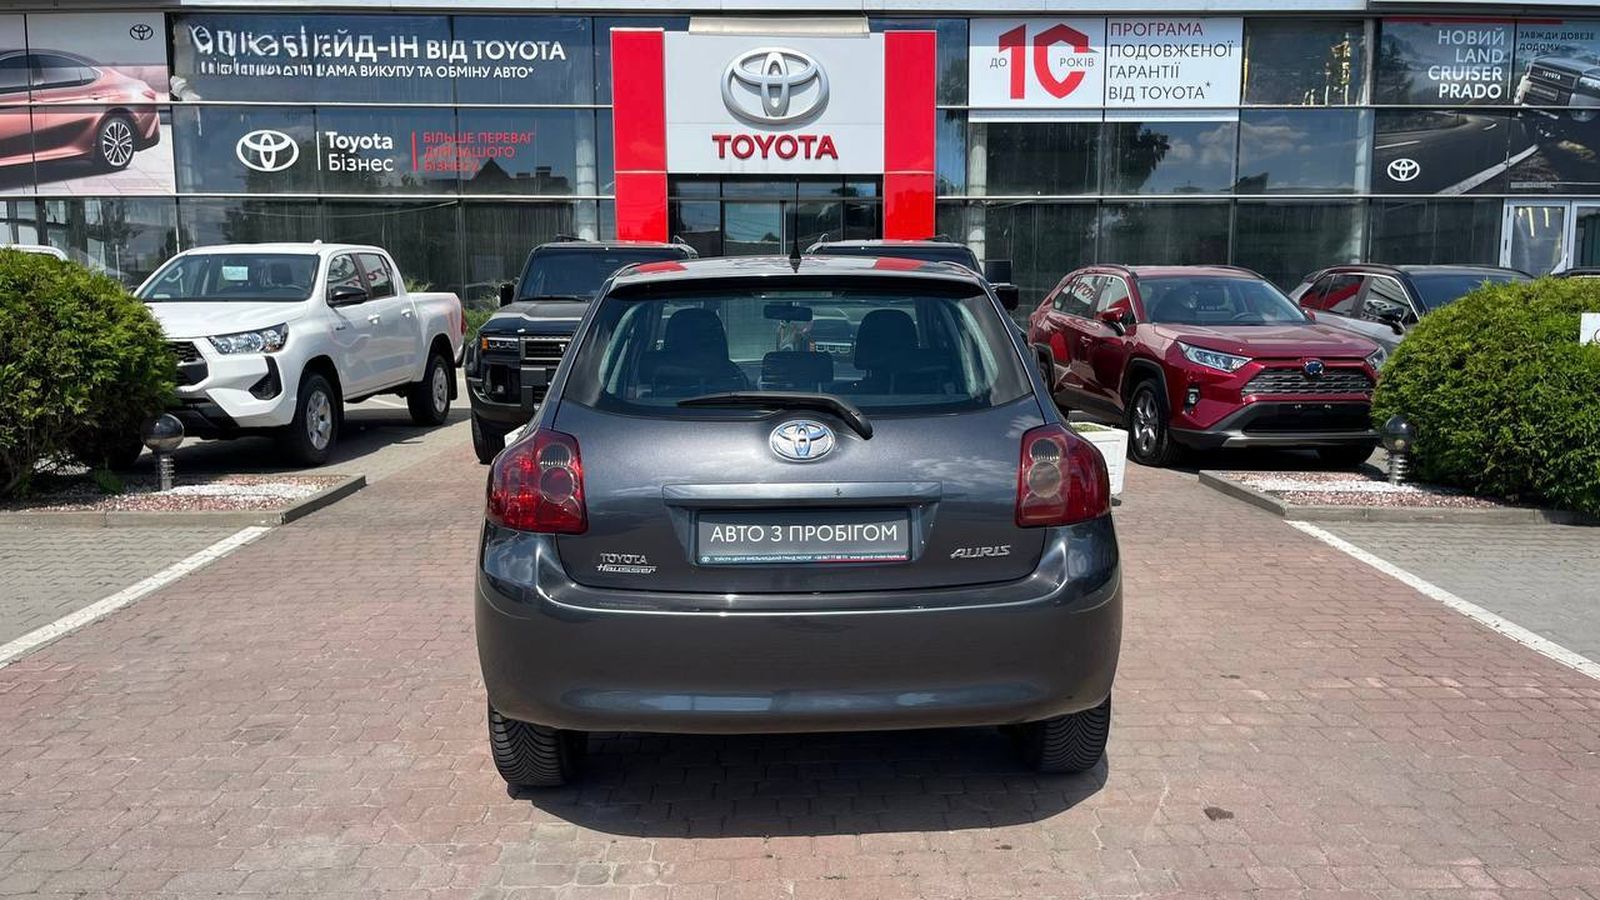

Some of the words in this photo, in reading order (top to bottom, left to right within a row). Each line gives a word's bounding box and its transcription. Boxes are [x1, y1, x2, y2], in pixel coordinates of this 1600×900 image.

[1109, 22, 1203, 37] ПРОГРАМА
[1438, 28, 1505, 46] НОВИЙ
[426, 40, 468, 62] ВІД
[473, 40, 566, 60] TOYOTA
[1109, 40, 1234, 59] ПОДОВЖЕНОЇ
[1455, 48, 1504, 64] LAND
[990, 57, 1007, 69] ДО
[1059, 57, 1095, 67] РОКІВ
[1108, 61, 1180, 79] ГАРАНТІЇ
[360, 65, 415, 77] ВИКУПУ
[417, 66, 433, 77] ТА
[436, 66, 491, 78] ОБМІНУ
[1428, 65, 1503, 81] CRUISER
[1108, 86, 1135, 101] ВІД
[1438, 83, 1502, 99] PRADO
[325, 131, 393, 153] Toyota
[423, 132, 475, 144] БІЛЬШЕ
[478, 132, 534, 144] ПЕРЕВАГ
[712, 134, 839, 160] TOYOTA
[329, 154, 394, 172] Бізнес
[710, 525, 764, 542] АВТО
[789, 524, 897, 542] ПРОБІГОМ
[600, 553, 648, 564] TOYOTA
[950, 545, 1011, 559] AURIS
